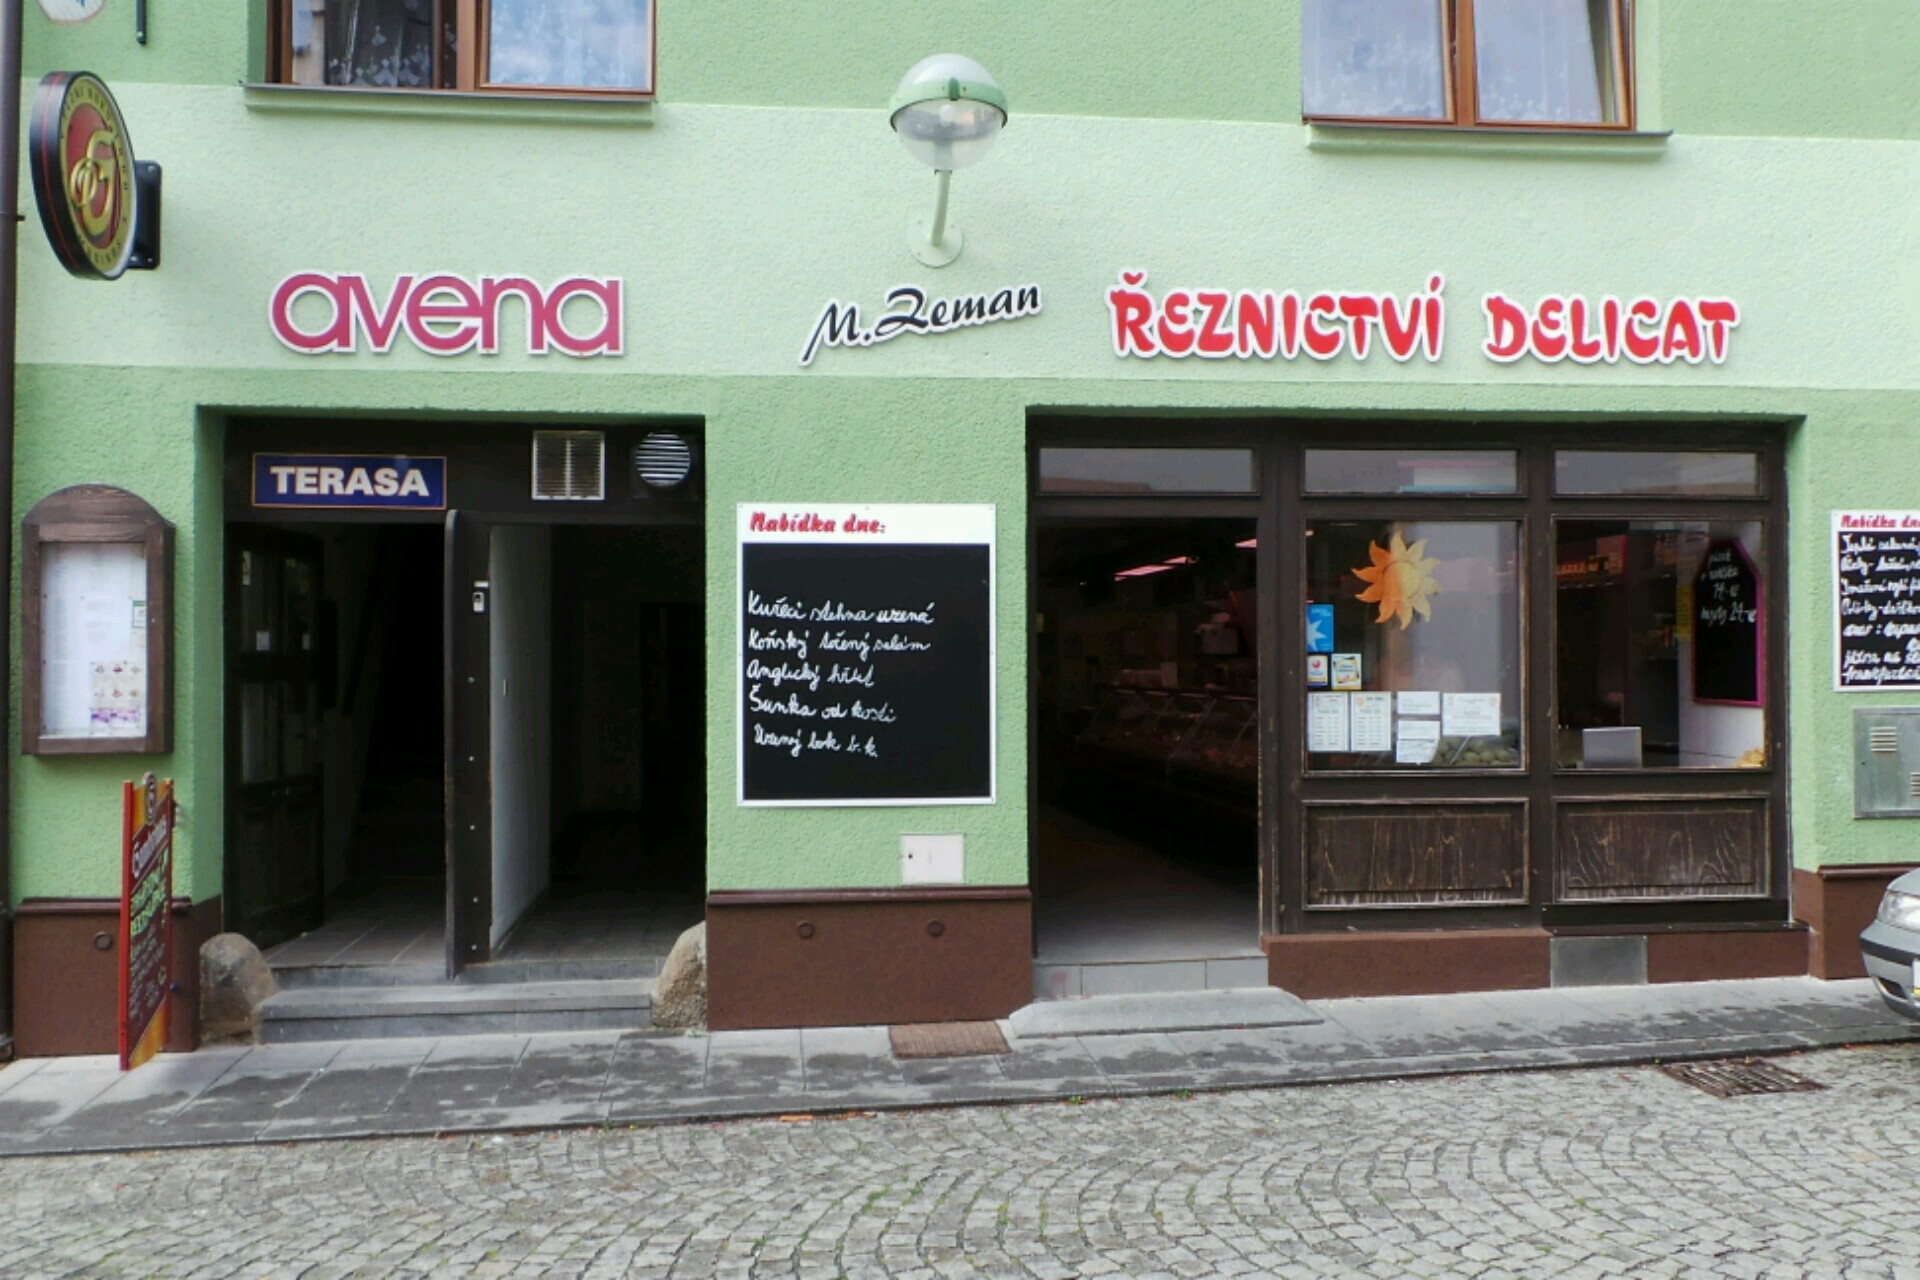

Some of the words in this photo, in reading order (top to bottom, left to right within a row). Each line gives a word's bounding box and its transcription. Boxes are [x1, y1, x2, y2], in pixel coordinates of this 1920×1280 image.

[271, 273, 623, 354] avena
[1110, 272, 1443, 358] ŘEZNICTVÍ
[1486, 295, 1737, 361] DELICAT
[270, 466, 430, 498] TERASA
[750, 511, 836, 532] Nabídka
[843, 513, 886, 534] dne:
[1902, 515, 1920, 528] dn
[748, 683, 816, 717] Šunka
